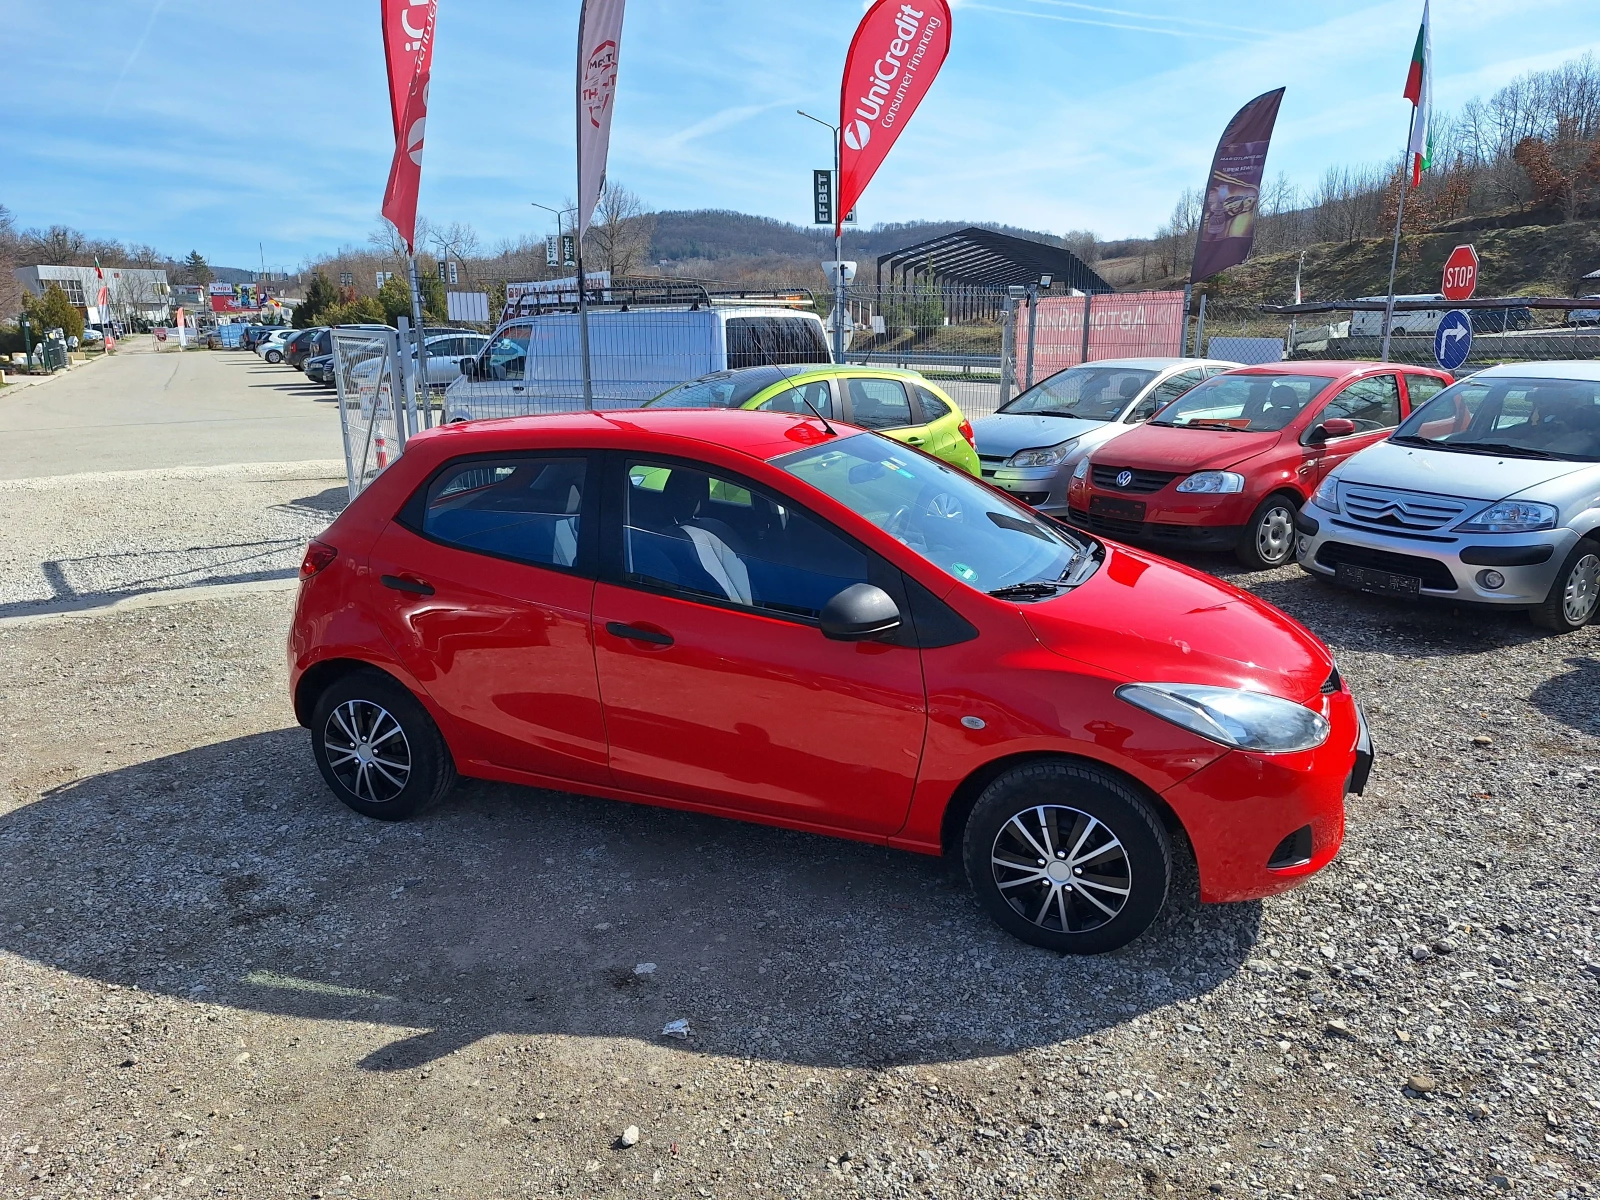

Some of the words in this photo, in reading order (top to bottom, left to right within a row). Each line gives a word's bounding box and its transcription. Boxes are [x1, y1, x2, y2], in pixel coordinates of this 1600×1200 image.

[856, 4, 924, 121] UniCredit
[881, 72, 914, 129] Consumer
[907, 16, 942, 72] Financing
[818, 173, 828, 221] EFBET
[1446, 266, 1474, 288] STOP
